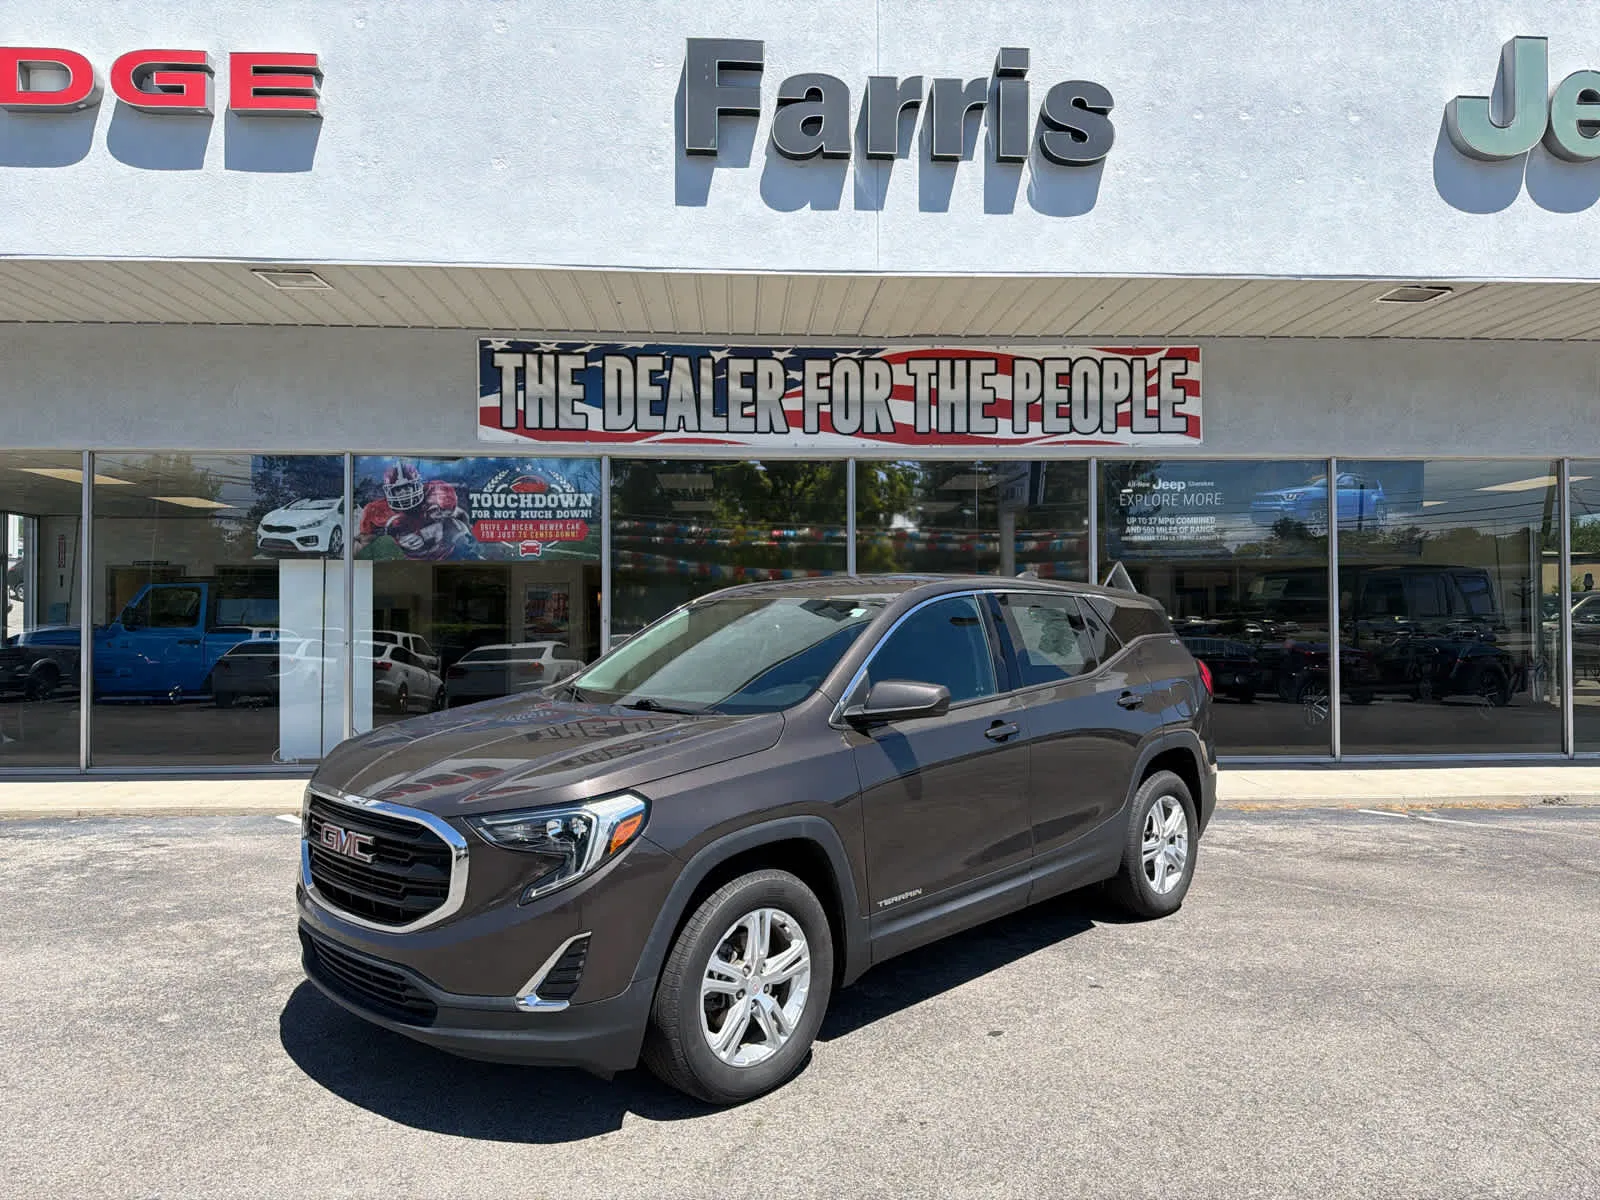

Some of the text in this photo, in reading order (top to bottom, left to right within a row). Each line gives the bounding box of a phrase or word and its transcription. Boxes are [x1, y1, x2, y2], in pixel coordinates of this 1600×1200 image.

[685, 37, 1116, 166] Farris
[491, 350, 1188, 434] THE DEALER FOR THE PEOPLE
[1152, 478, 1186, 492] Jeep
[469, 493, 593, 508] TOUCHDOWN
[1119, 493, 1180, 507] EXPLORE
[471, 509, 592, 519] FOR NOT MUCH DOWN!
[1126, 517, 1136, 525] UP
[1138, 517, 1147, 525] TO
[1158, 517, 1175, 525] MPG
[1176, 516, 1216, 525] COMBINED
[1125, 526, 1142, 534] AND
[1156, 526, 1178, 534] MILES
[1179, 526, 1189, 534] OF
[320, 822, 376, 864] GMC
